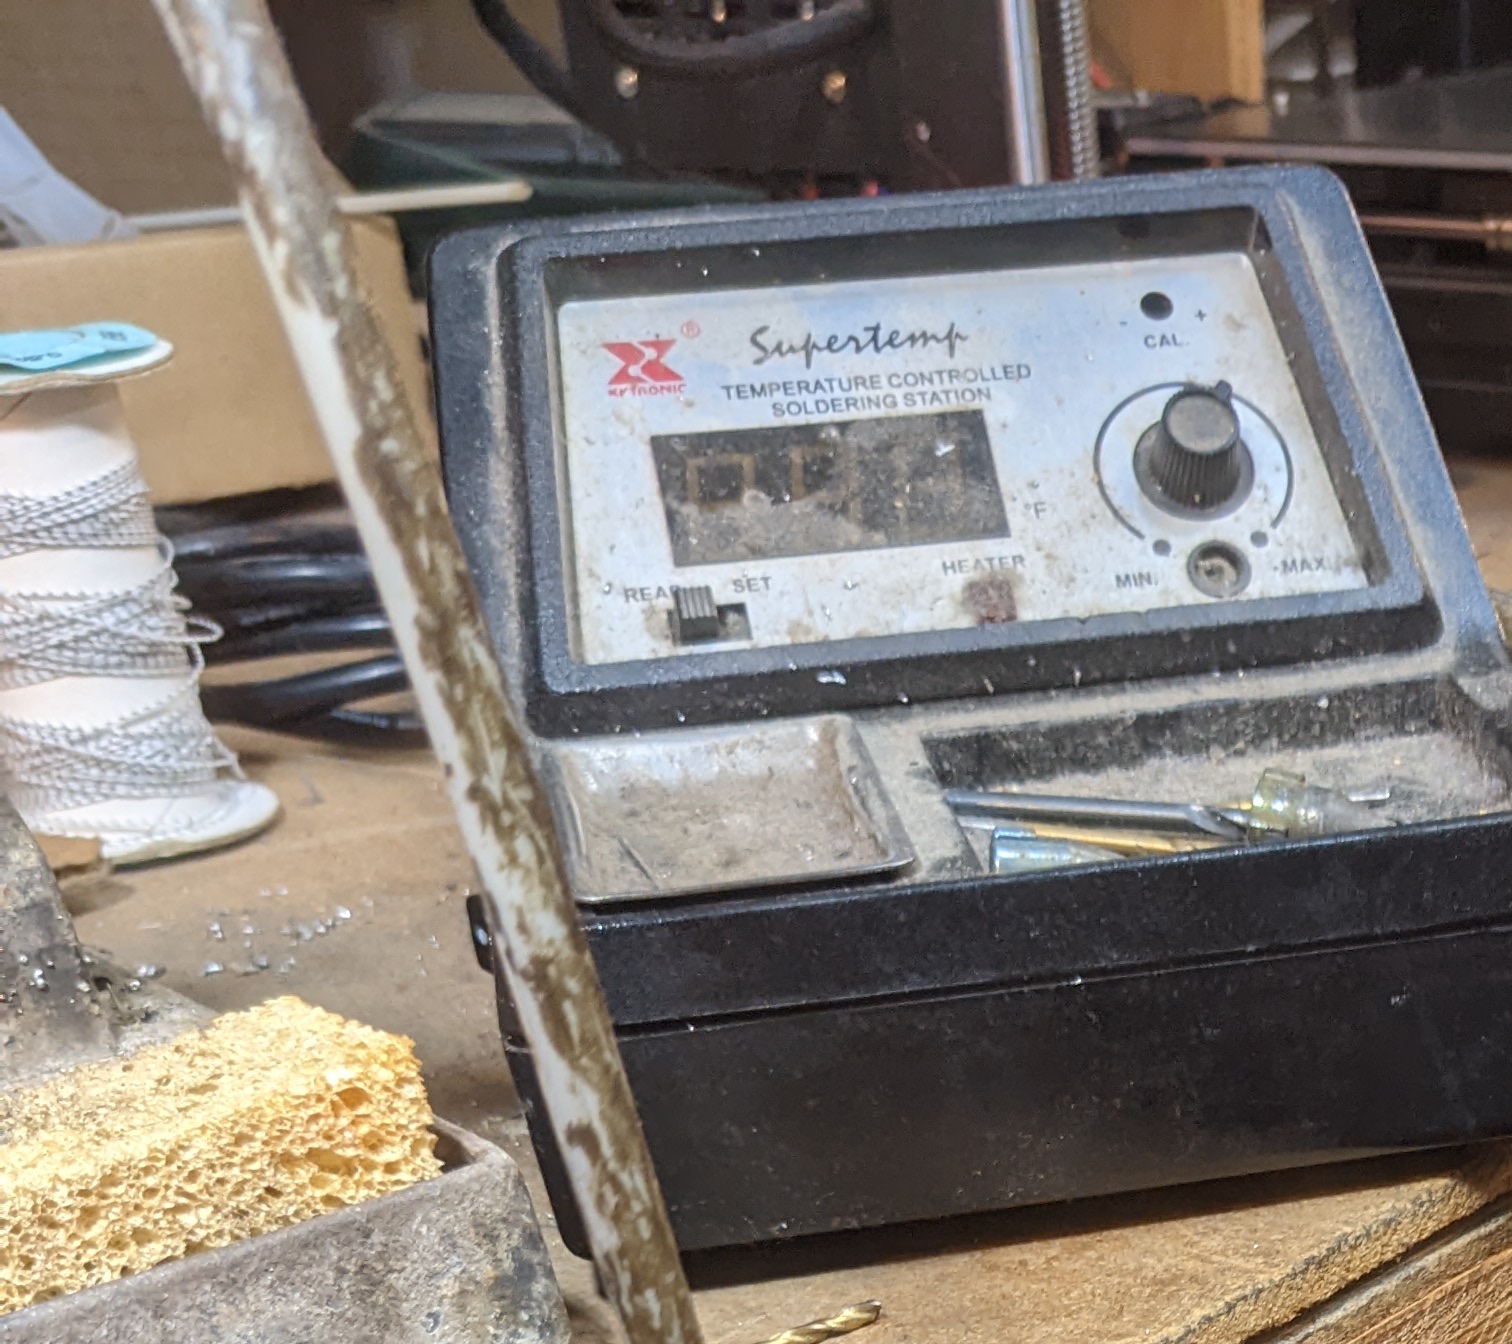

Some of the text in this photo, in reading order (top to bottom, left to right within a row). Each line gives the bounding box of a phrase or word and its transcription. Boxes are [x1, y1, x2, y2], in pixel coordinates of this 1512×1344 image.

[749, 321, 970, 369] Supertemp
[720, 362, 1033, 402] TEMPERATURE CONTROLLED
[771, 384, 993, 418] SOLDERING STATION
[941, 553, 1027, 577] HEATER
[732, 575, 773, 594] SET
